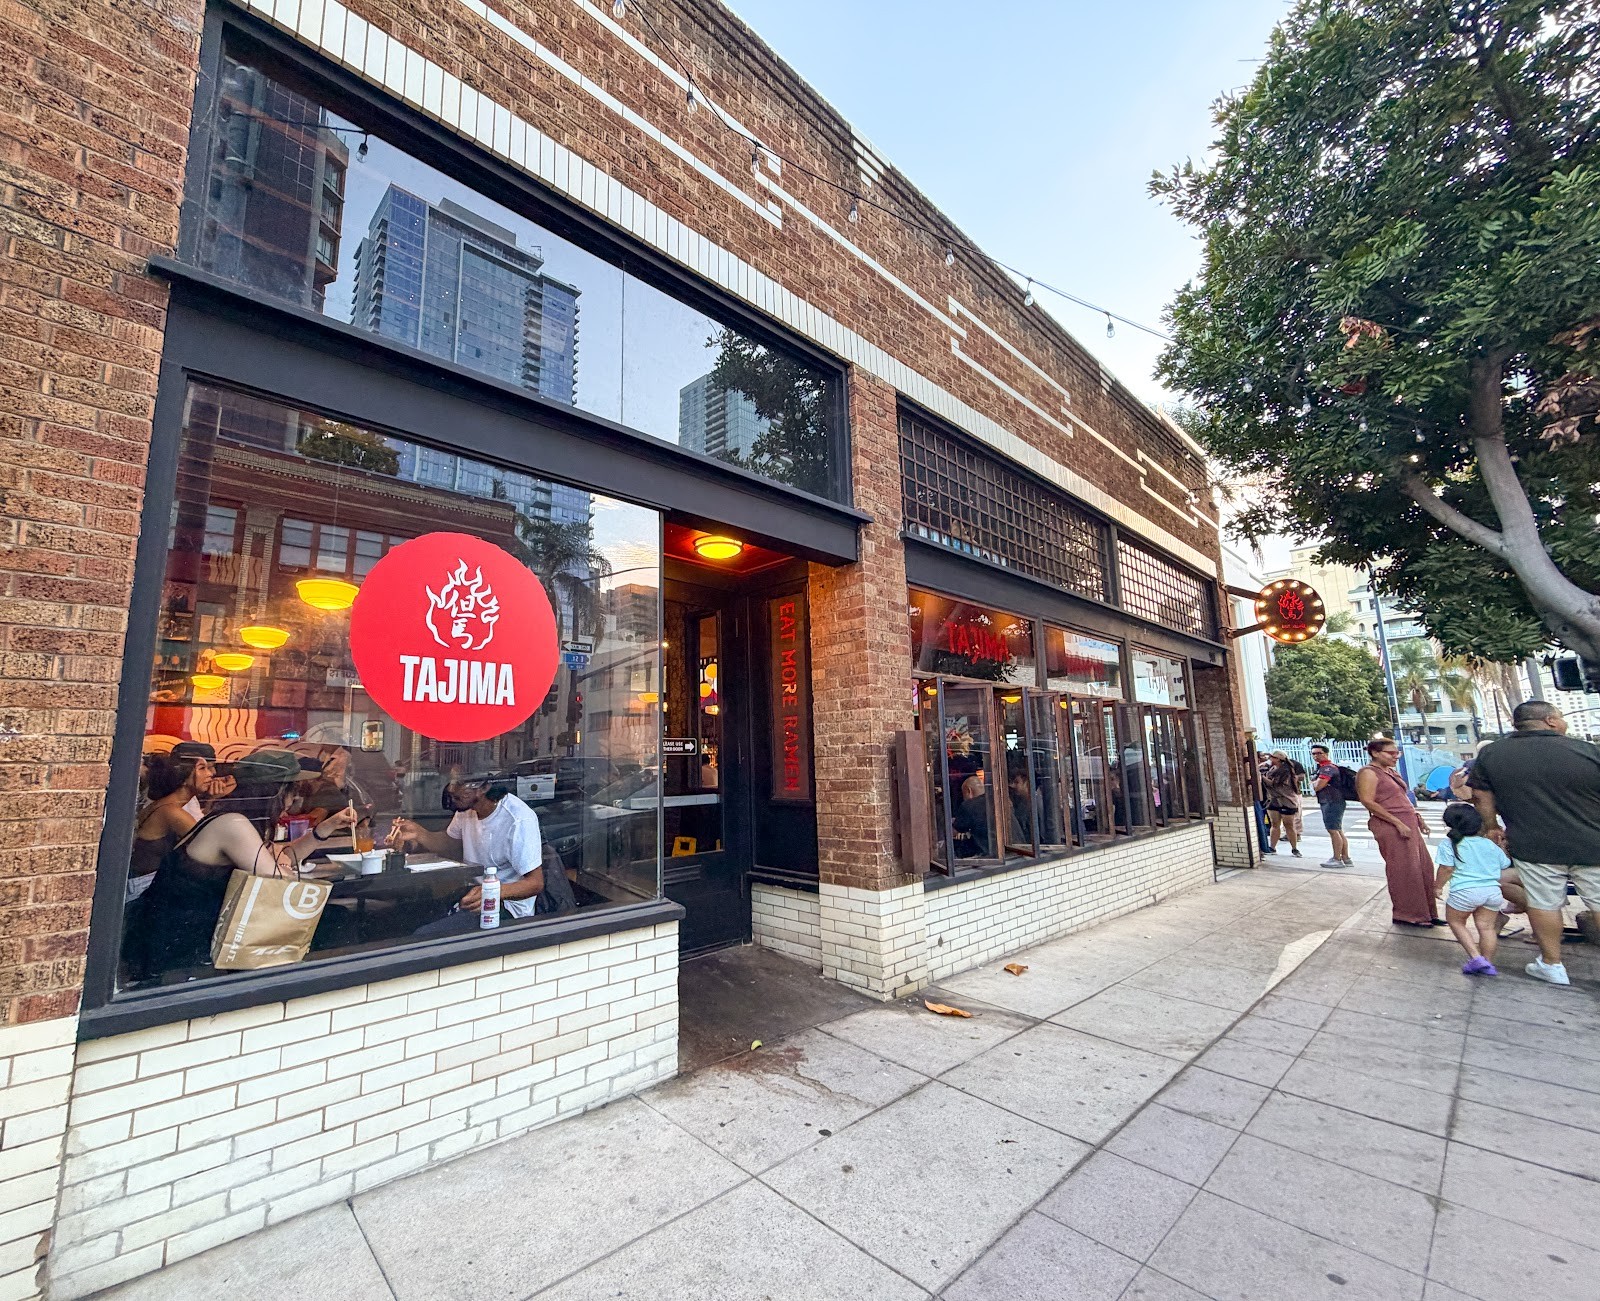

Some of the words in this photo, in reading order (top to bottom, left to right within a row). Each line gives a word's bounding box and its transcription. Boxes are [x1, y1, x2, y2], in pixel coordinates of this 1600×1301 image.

[780, 602, 796, 643] EAT
[944, 621, 1010, 664] TAJIMA
[400, 655, 515, 705] TAJIMA
[781, 648, 798, 708] MORE
[783, 715, 801, 792] RAMEN
[298, 884, 321, 908] B
